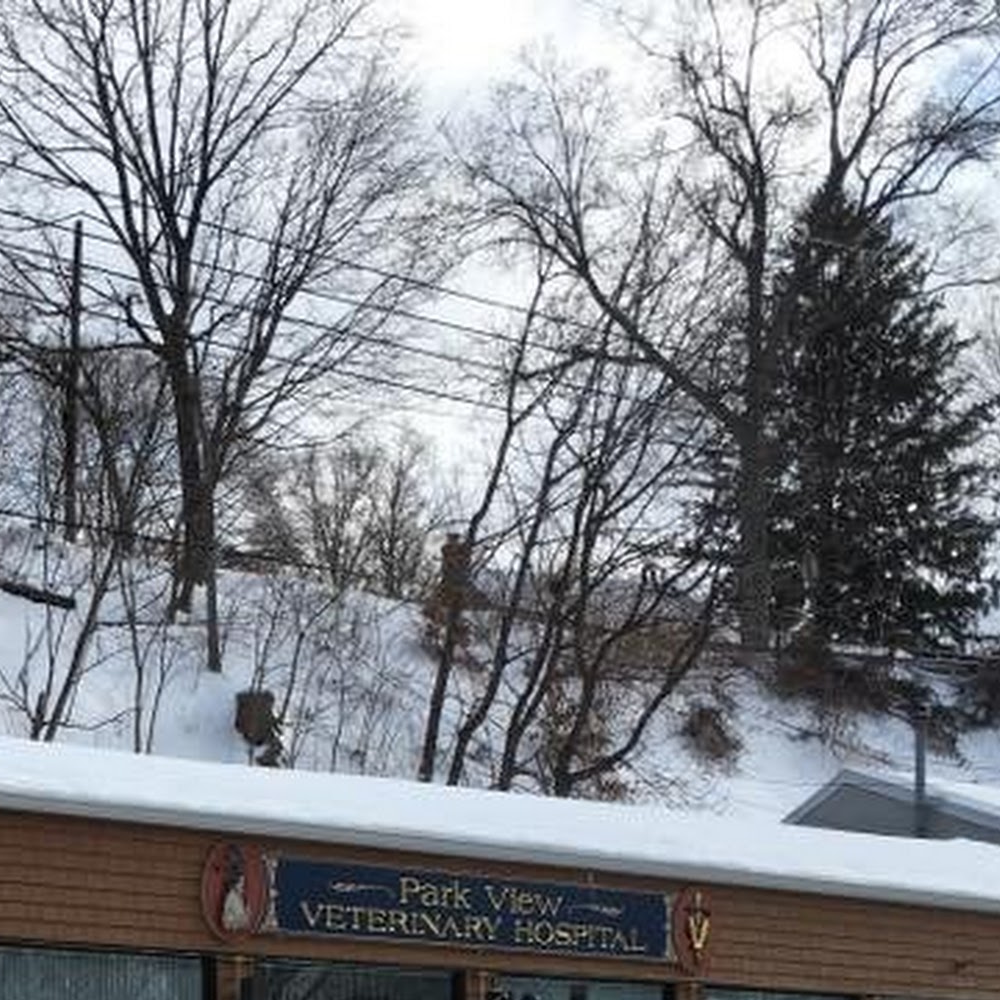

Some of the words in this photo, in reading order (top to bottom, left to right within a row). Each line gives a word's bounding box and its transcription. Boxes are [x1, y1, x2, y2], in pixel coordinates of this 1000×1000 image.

[400, 877, 471, 909] Park
[484, 885, 563, 916] View
[301, 901, 500, 941] VETERINARY
[514, 919, 646, 951] HOSPITAL
